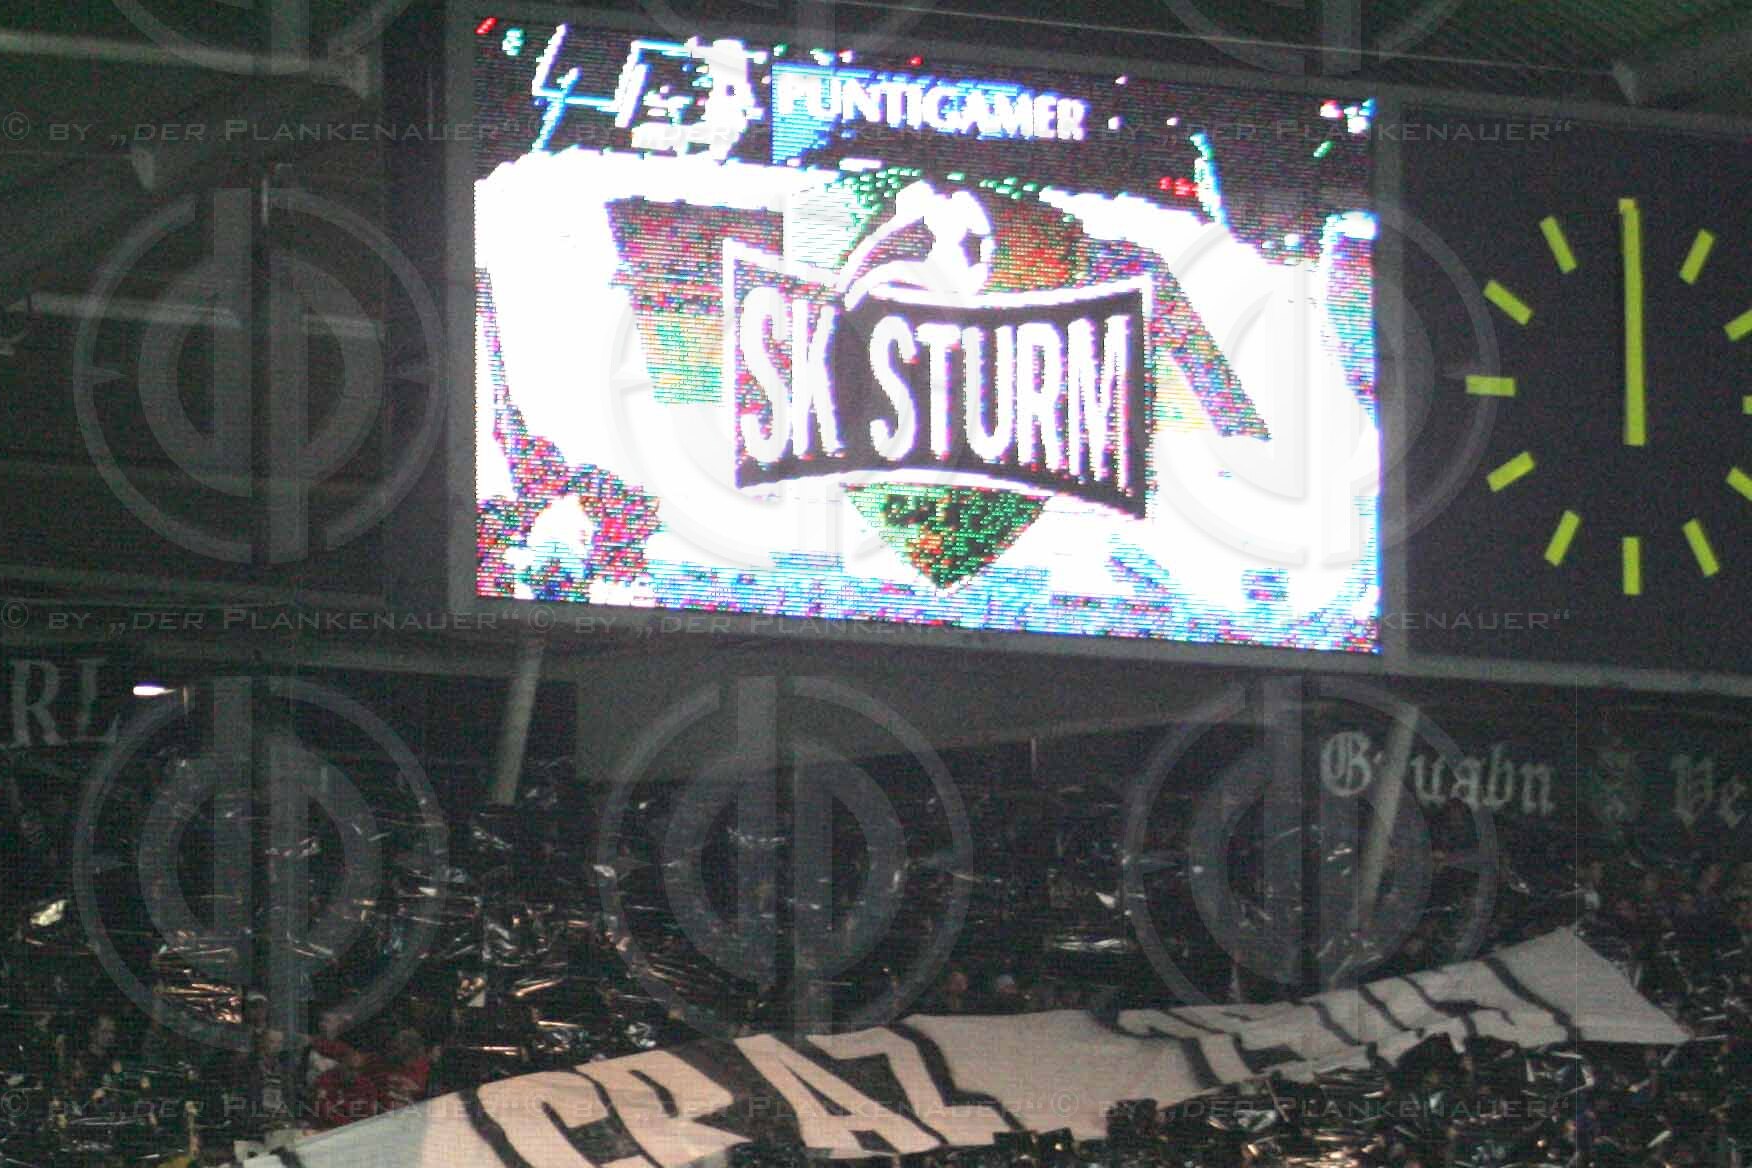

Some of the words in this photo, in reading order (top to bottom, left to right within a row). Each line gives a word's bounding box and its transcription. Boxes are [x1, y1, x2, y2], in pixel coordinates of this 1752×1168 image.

[776, 71, 1089, 142] PUNTIGAMER
[739, 286, 846, 464] SK
[869, 314, 1134, 493] STURM
[1319, 730, 1555, 816] Guabn
